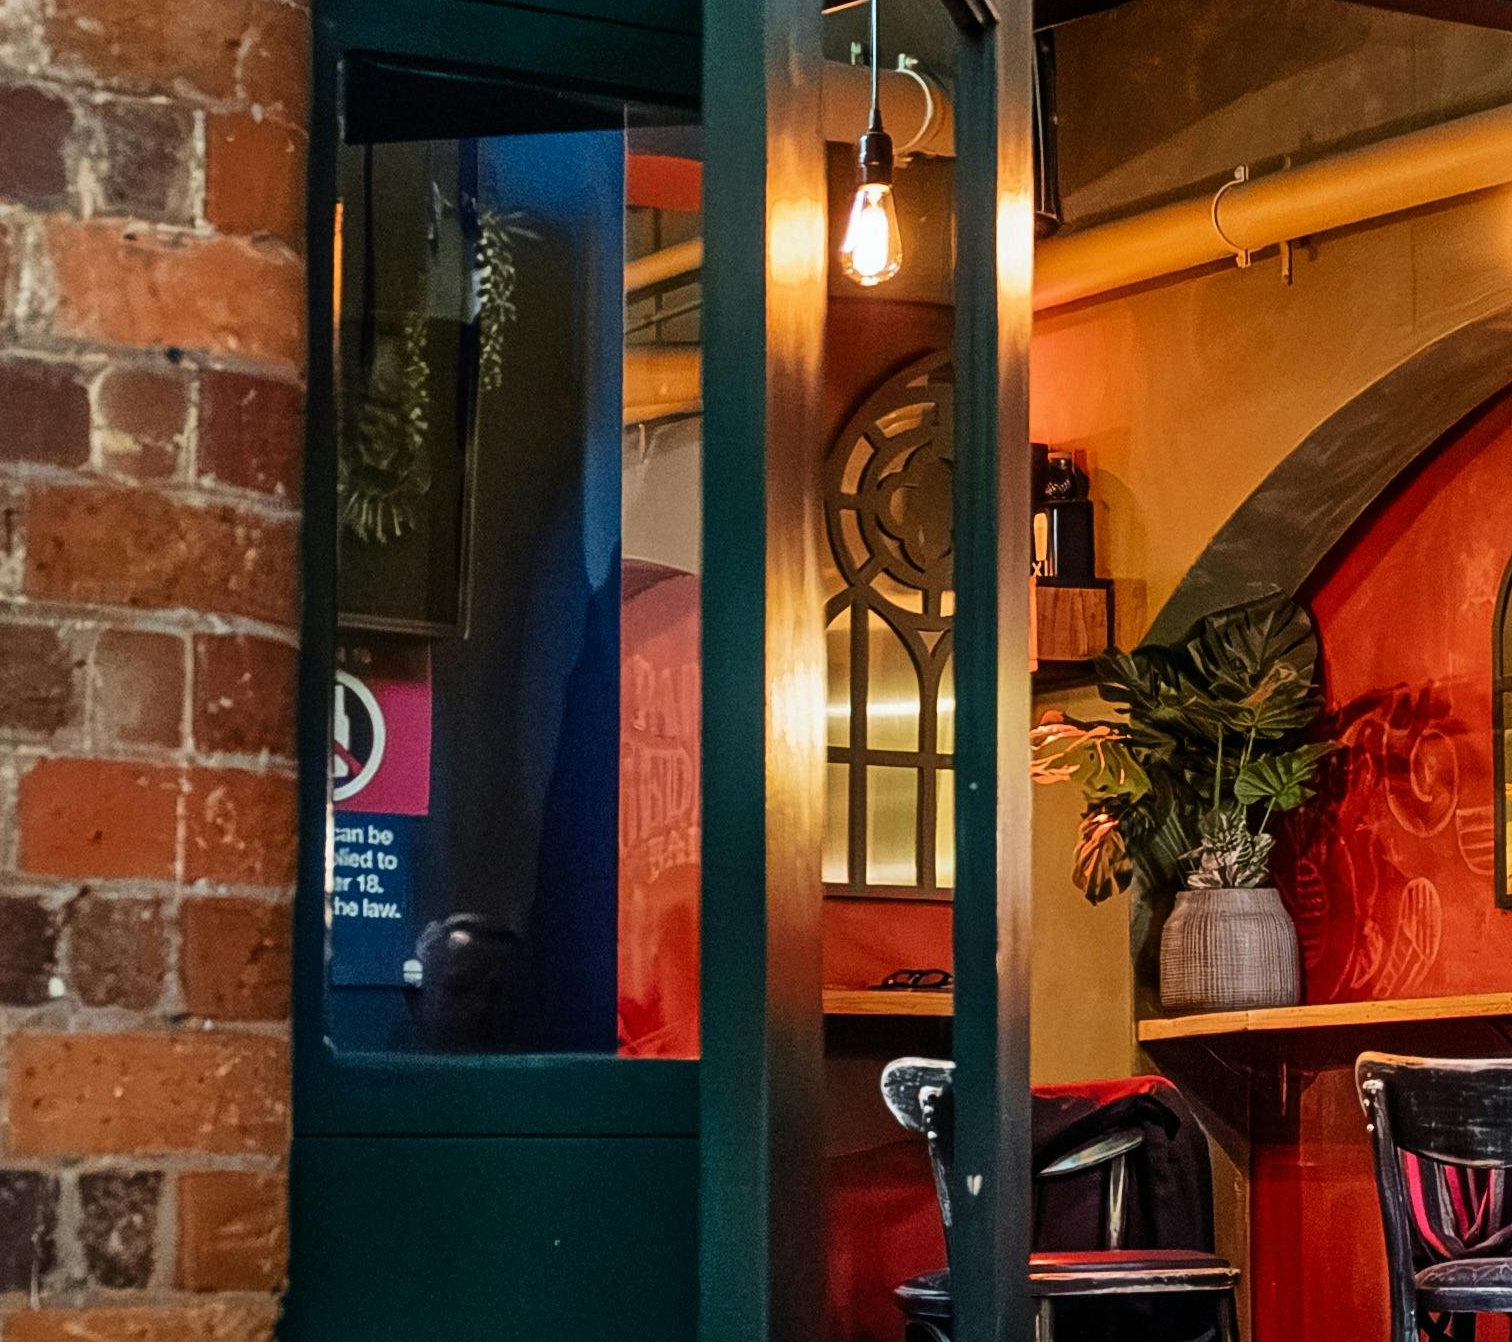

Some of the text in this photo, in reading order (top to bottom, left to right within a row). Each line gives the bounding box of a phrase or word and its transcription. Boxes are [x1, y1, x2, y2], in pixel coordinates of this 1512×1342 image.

[368, 825, 394, 845] be
[377, 851, 398, 870] to
[356, 873, 385, 894] 18.
[362, 898, 402, 919] law.
